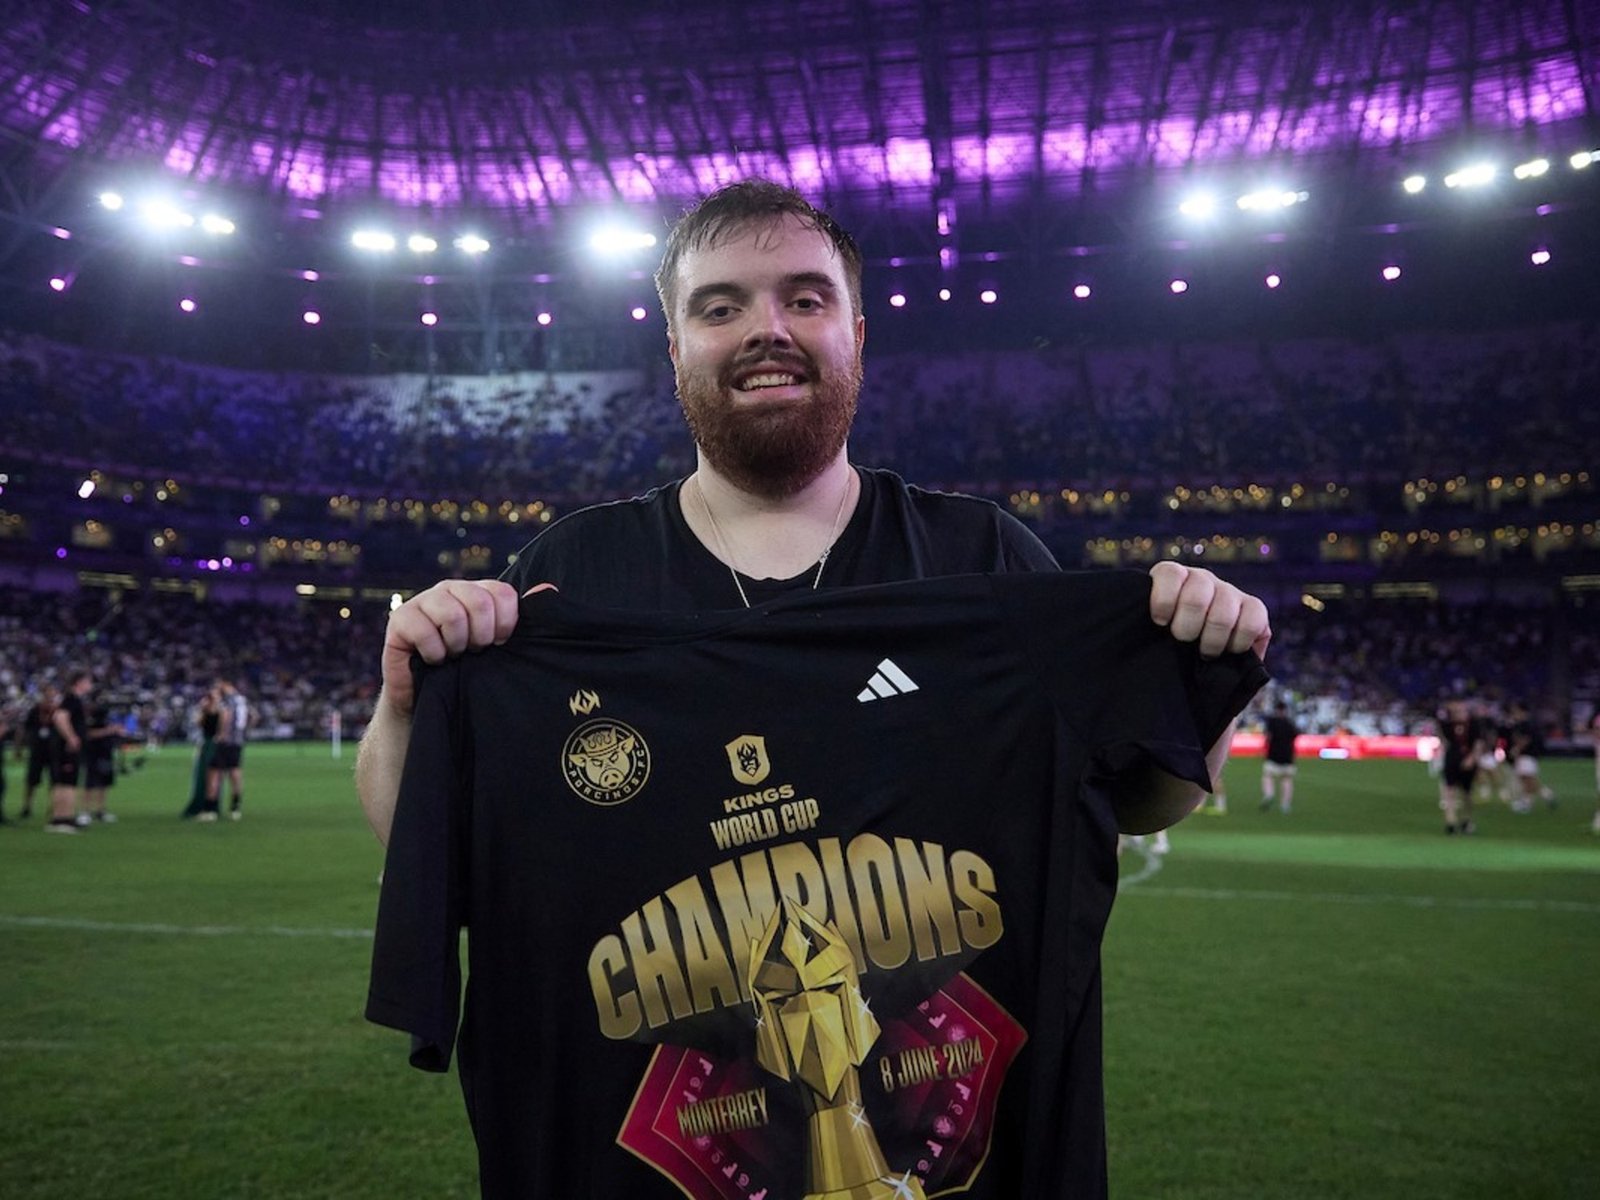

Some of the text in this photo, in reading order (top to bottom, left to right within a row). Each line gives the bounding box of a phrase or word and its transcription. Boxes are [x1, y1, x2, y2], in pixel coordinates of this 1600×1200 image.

[569, 770, 640, 800] PORCINOS
[723, 784, 795, 813] KINGS
[710, 798, 820, 850] WORLD CUP
[587, 832, 1004, 1039] CHAMPIONS
[880, 1035, 984, 1093] 8 JUNE 2024
[676, 1087, 769, 1139] MONTERREY
